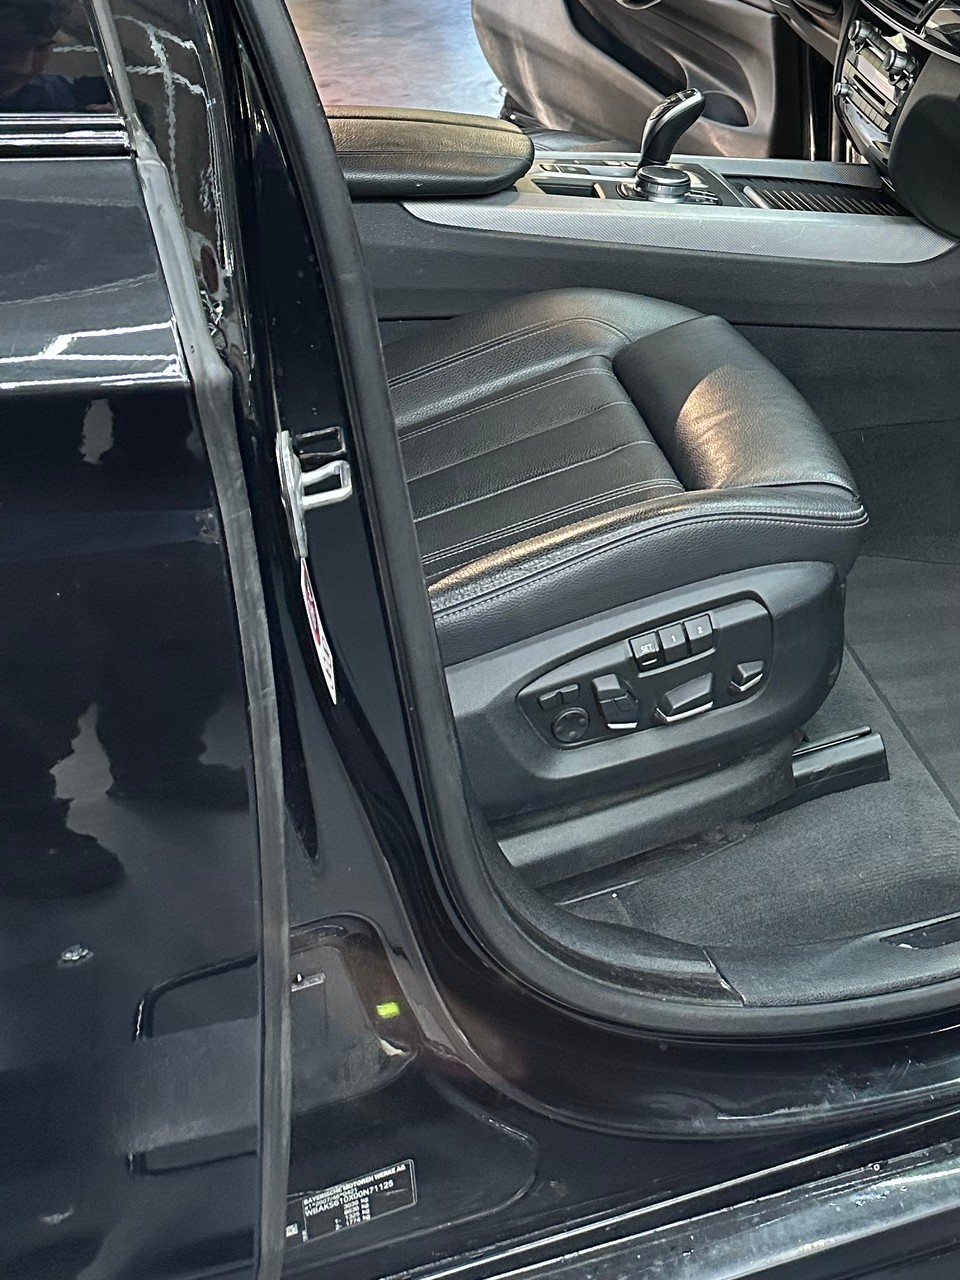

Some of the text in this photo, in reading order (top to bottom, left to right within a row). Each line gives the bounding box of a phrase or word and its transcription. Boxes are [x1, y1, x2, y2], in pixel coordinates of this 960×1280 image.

[697, 626, 704, 634] 2
[640, 643, 653, 654] SET
[303, 1164, 406, 1205] BAYERISCHE MOTOREN WERKE AG
